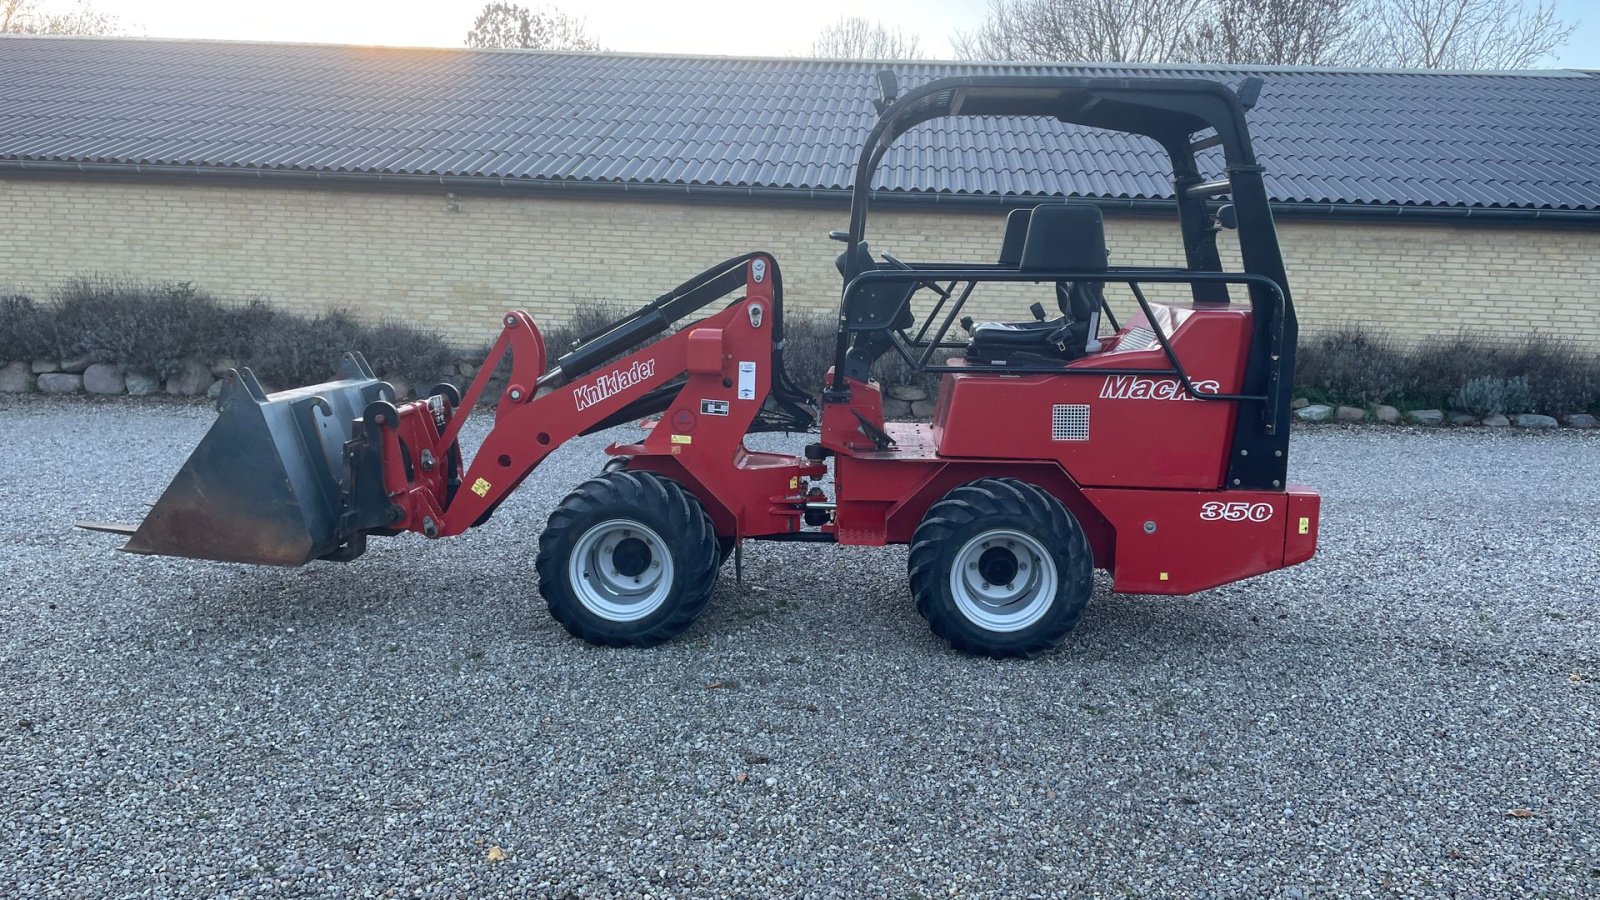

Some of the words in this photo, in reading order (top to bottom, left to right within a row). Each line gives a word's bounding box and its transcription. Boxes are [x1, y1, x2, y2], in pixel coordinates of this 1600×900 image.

[573, 358, 655, 411] Kniklader
[1099, 375, 1220, 401] Macks
[1200, 501, 1273, 522] 350
